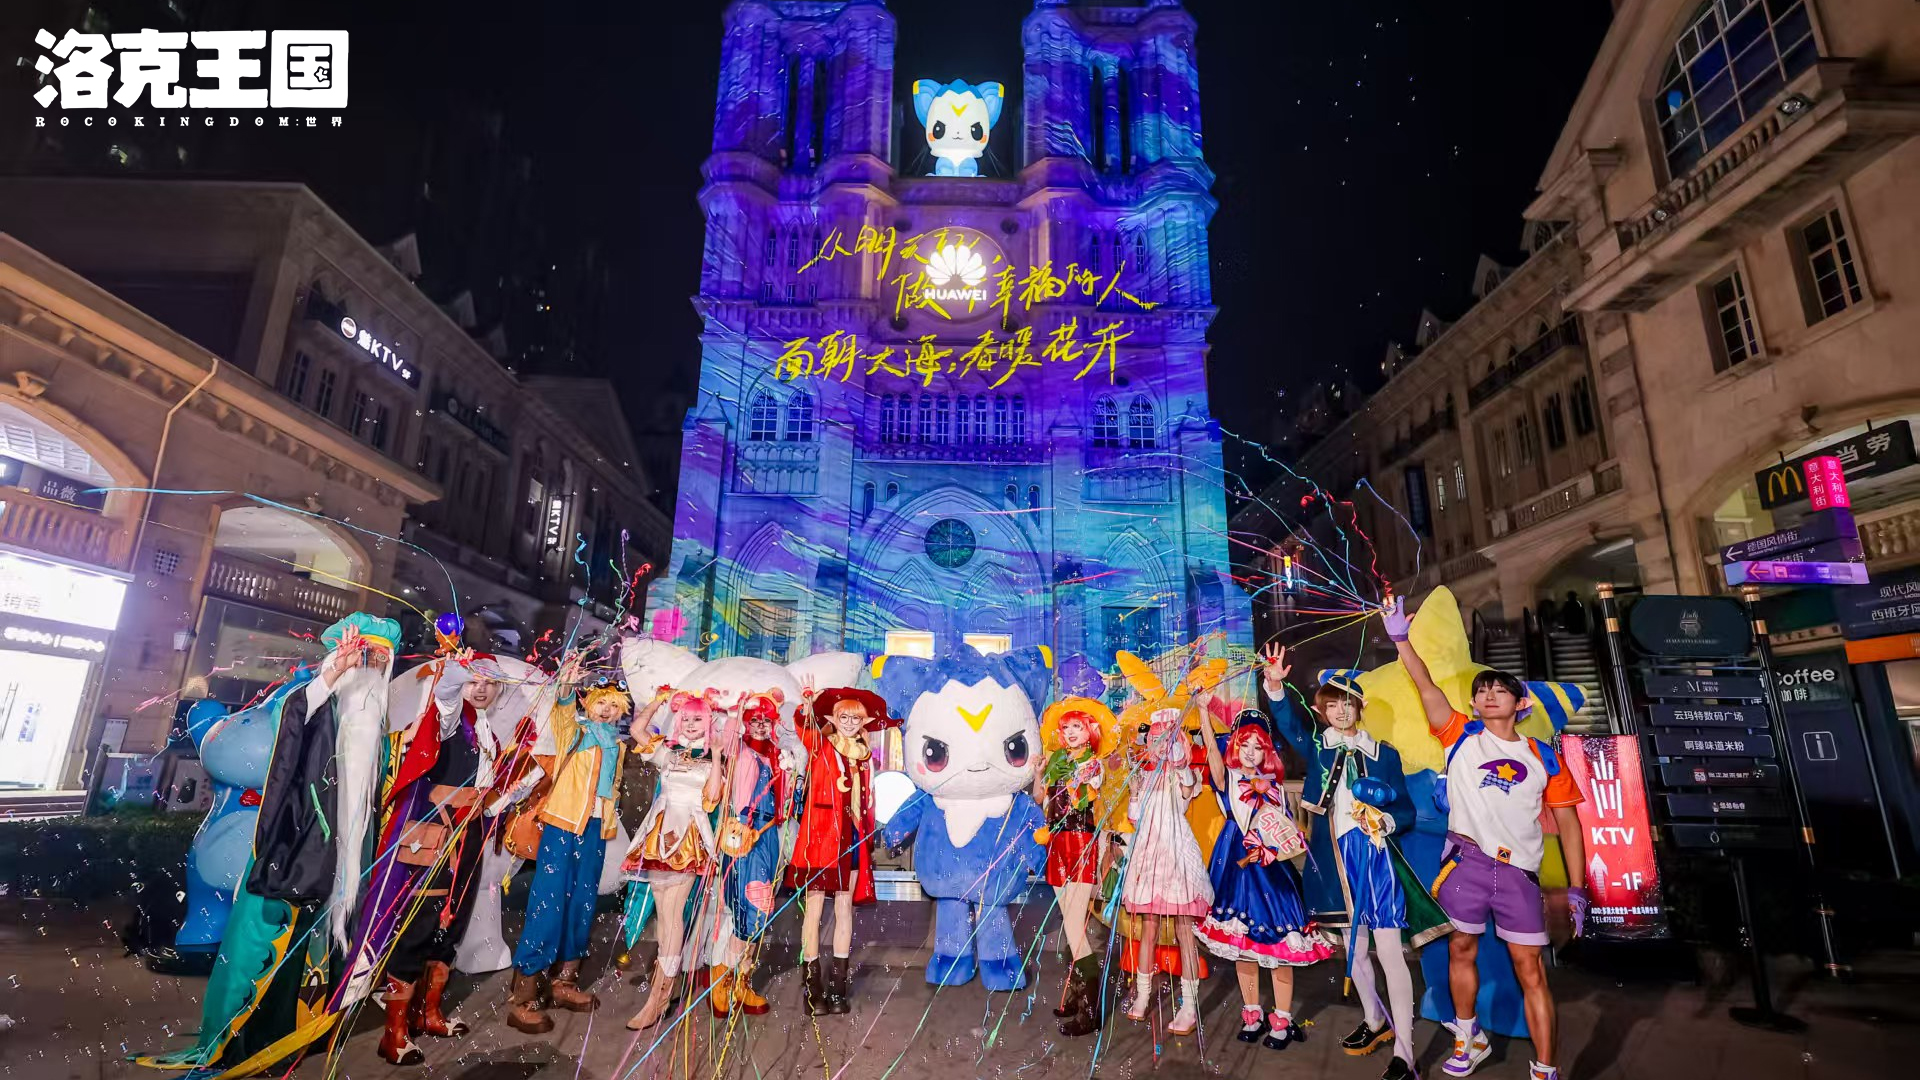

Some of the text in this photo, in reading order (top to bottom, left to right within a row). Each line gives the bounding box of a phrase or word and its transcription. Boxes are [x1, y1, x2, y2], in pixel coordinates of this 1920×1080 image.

[924, 289, 987, 300] HUAWEI
[1808, 462, 1827, 507] 意大利街
[1826, 460, 1845, 504] 意大利街
[1748, 530, 1798, 552] 德国风情街
[1880, 581, 1920, 598] 现代风
[1674, 710, 1744, 721] 云玛特数码广场
[1259, 811, 1302, 854] SALE
[1591, 826, 1635, 846] KTV
[1611, 871, 1643, 891] -1F
